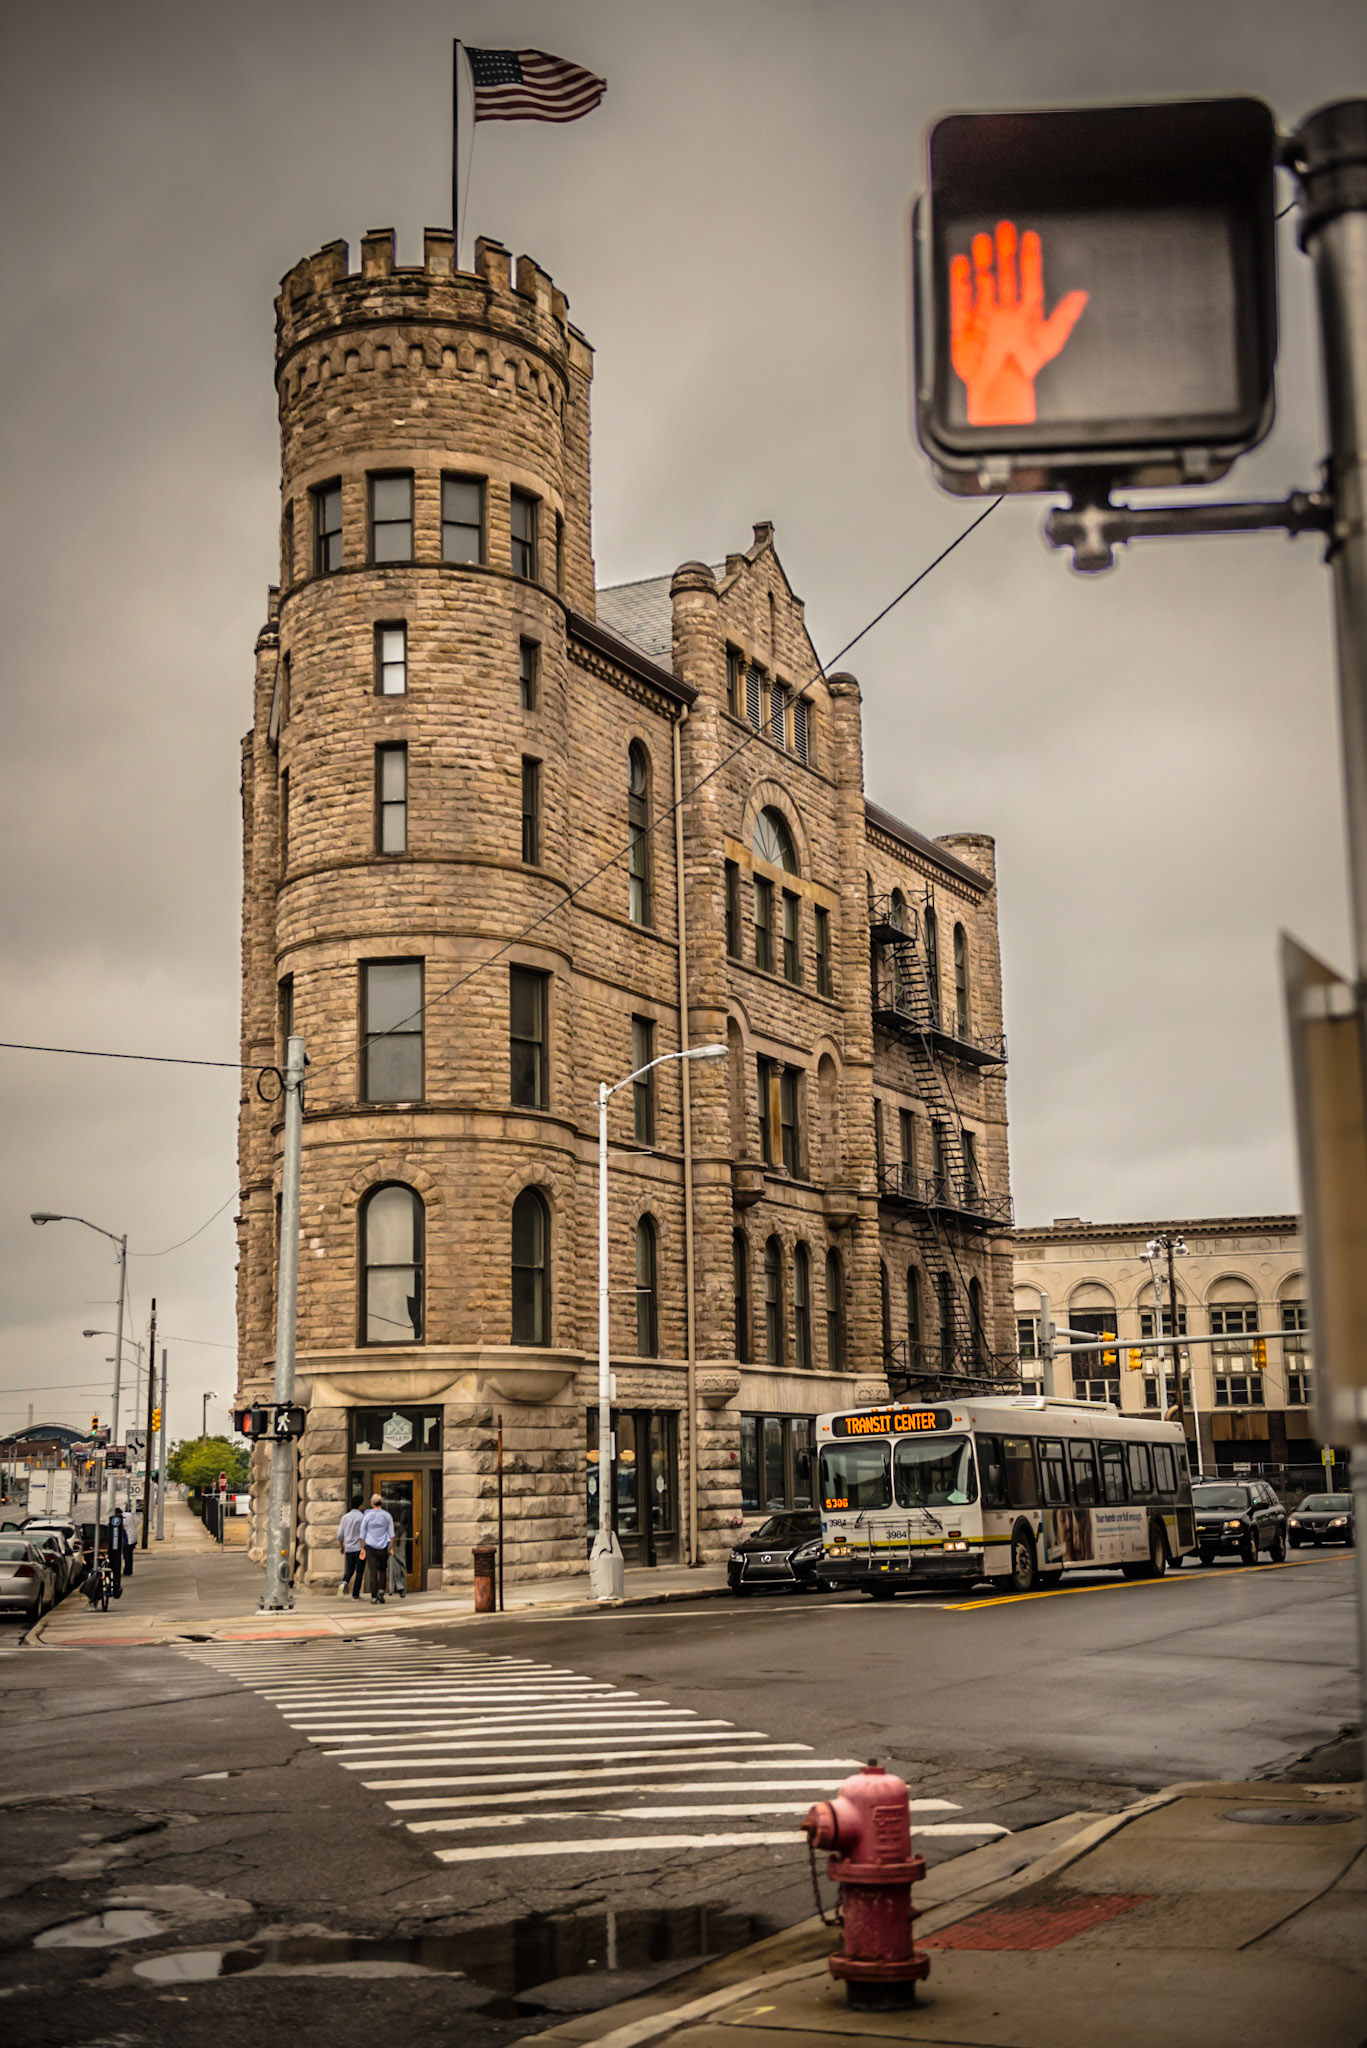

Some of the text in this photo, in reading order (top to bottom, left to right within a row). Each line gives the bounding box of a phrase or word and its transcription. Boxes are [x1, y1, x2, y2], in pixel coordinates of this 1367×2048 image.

[1257, 1236, 1289, 1251] OF
[845, 1411, 937, 1434] TRANSIT CENTER
[129, 1486, 141, 1494] 30
[828, 1518, 847, 1528] 3984
[886, 1530, 907, 1539] 3984
